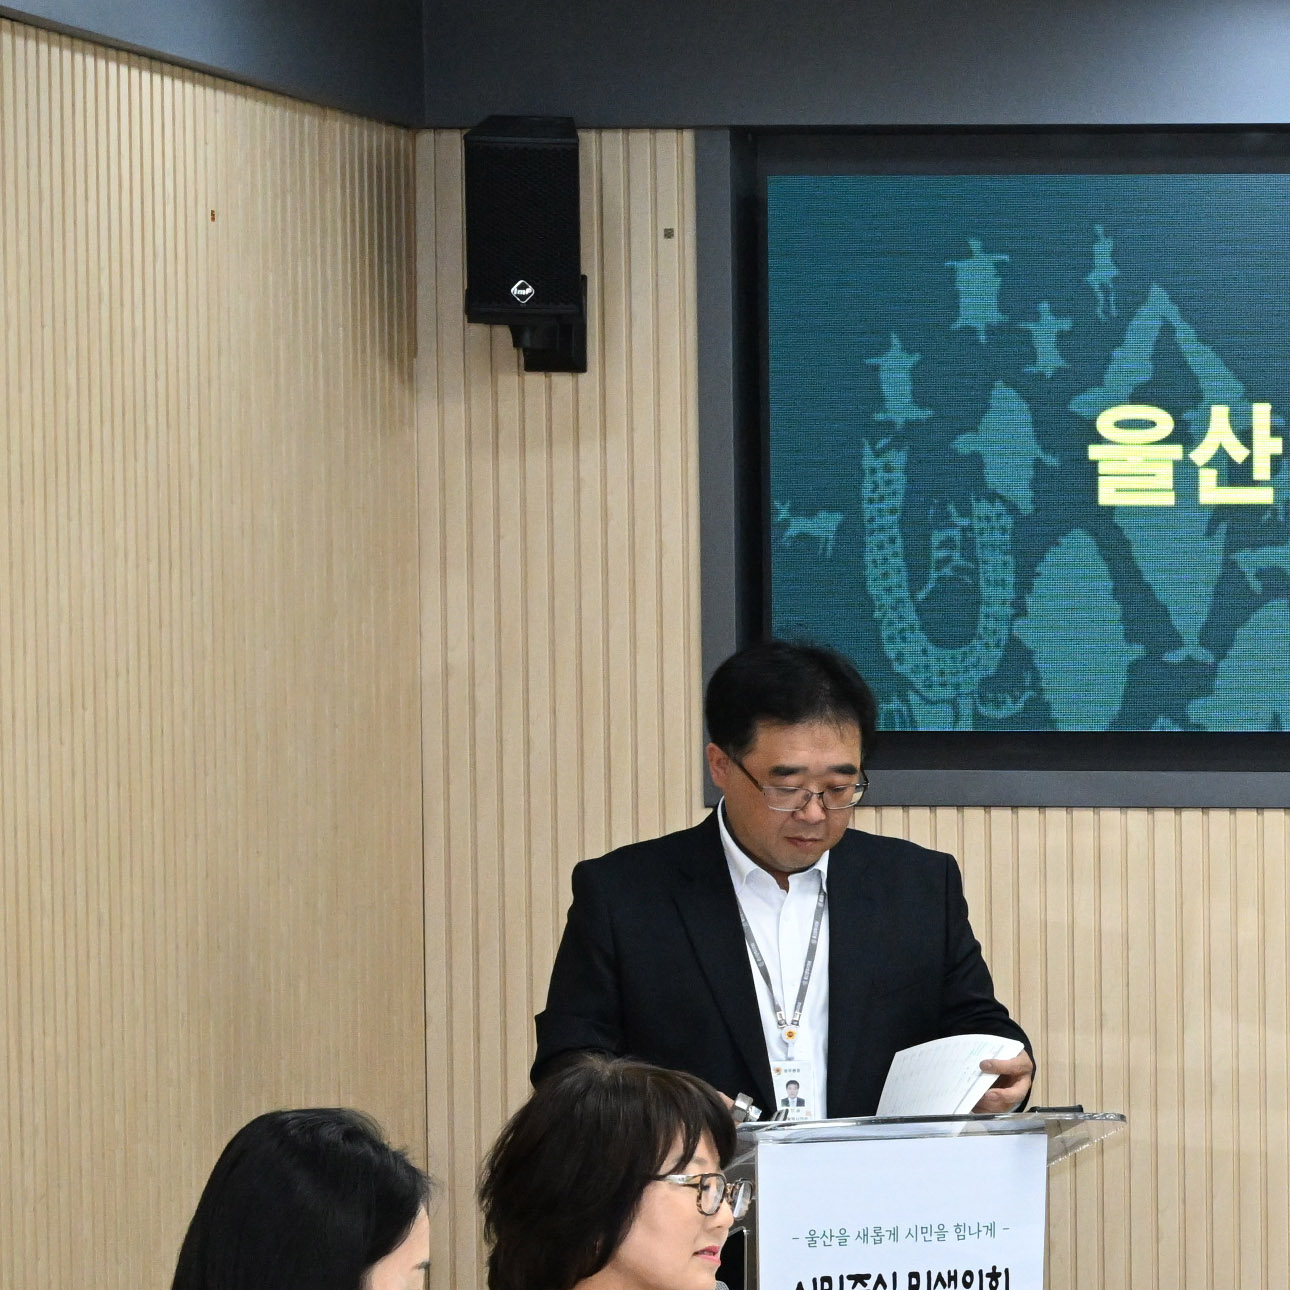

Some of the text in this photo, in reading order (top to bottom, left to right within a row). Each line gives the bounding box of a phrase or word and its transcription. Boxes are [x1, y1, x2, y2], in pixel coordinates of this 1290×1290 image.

[1087, 402, 1283, 507] 울산
[805, 1221, 996, 1248] 울산을 새롭게 시민을 힘나게
